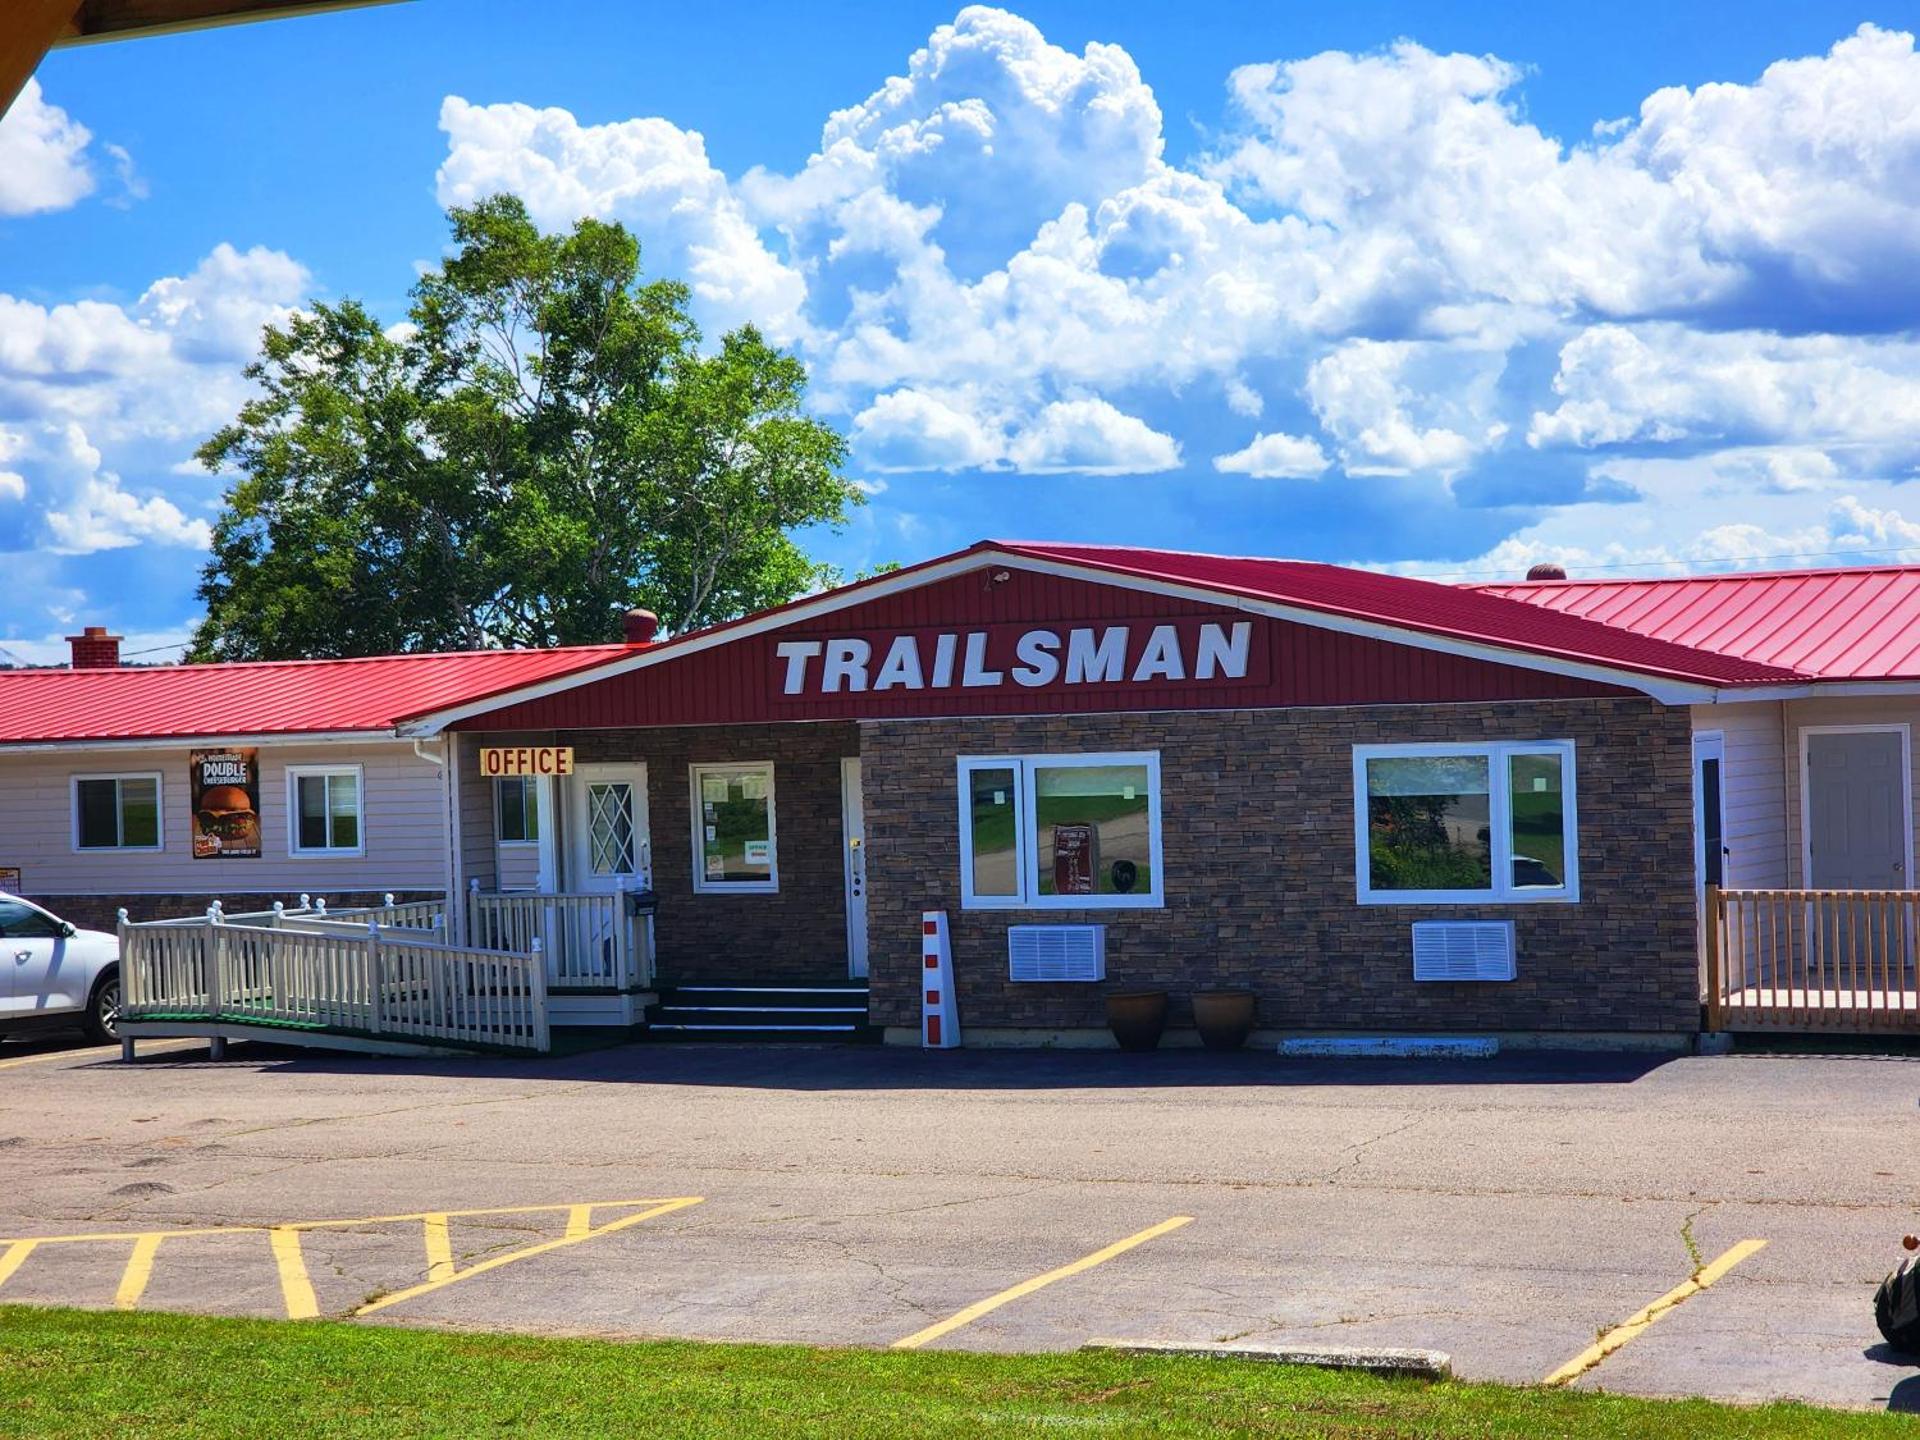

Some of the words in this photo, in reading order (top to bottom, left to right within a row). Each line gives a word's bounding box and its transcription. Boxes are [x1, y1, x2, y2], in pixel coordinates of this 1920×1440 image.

[776, 621, 1253, 695] TRAILSMAN
[203, 762, 247, 777] DOUBLE
[487, 748, 567, 774] OFFICE
